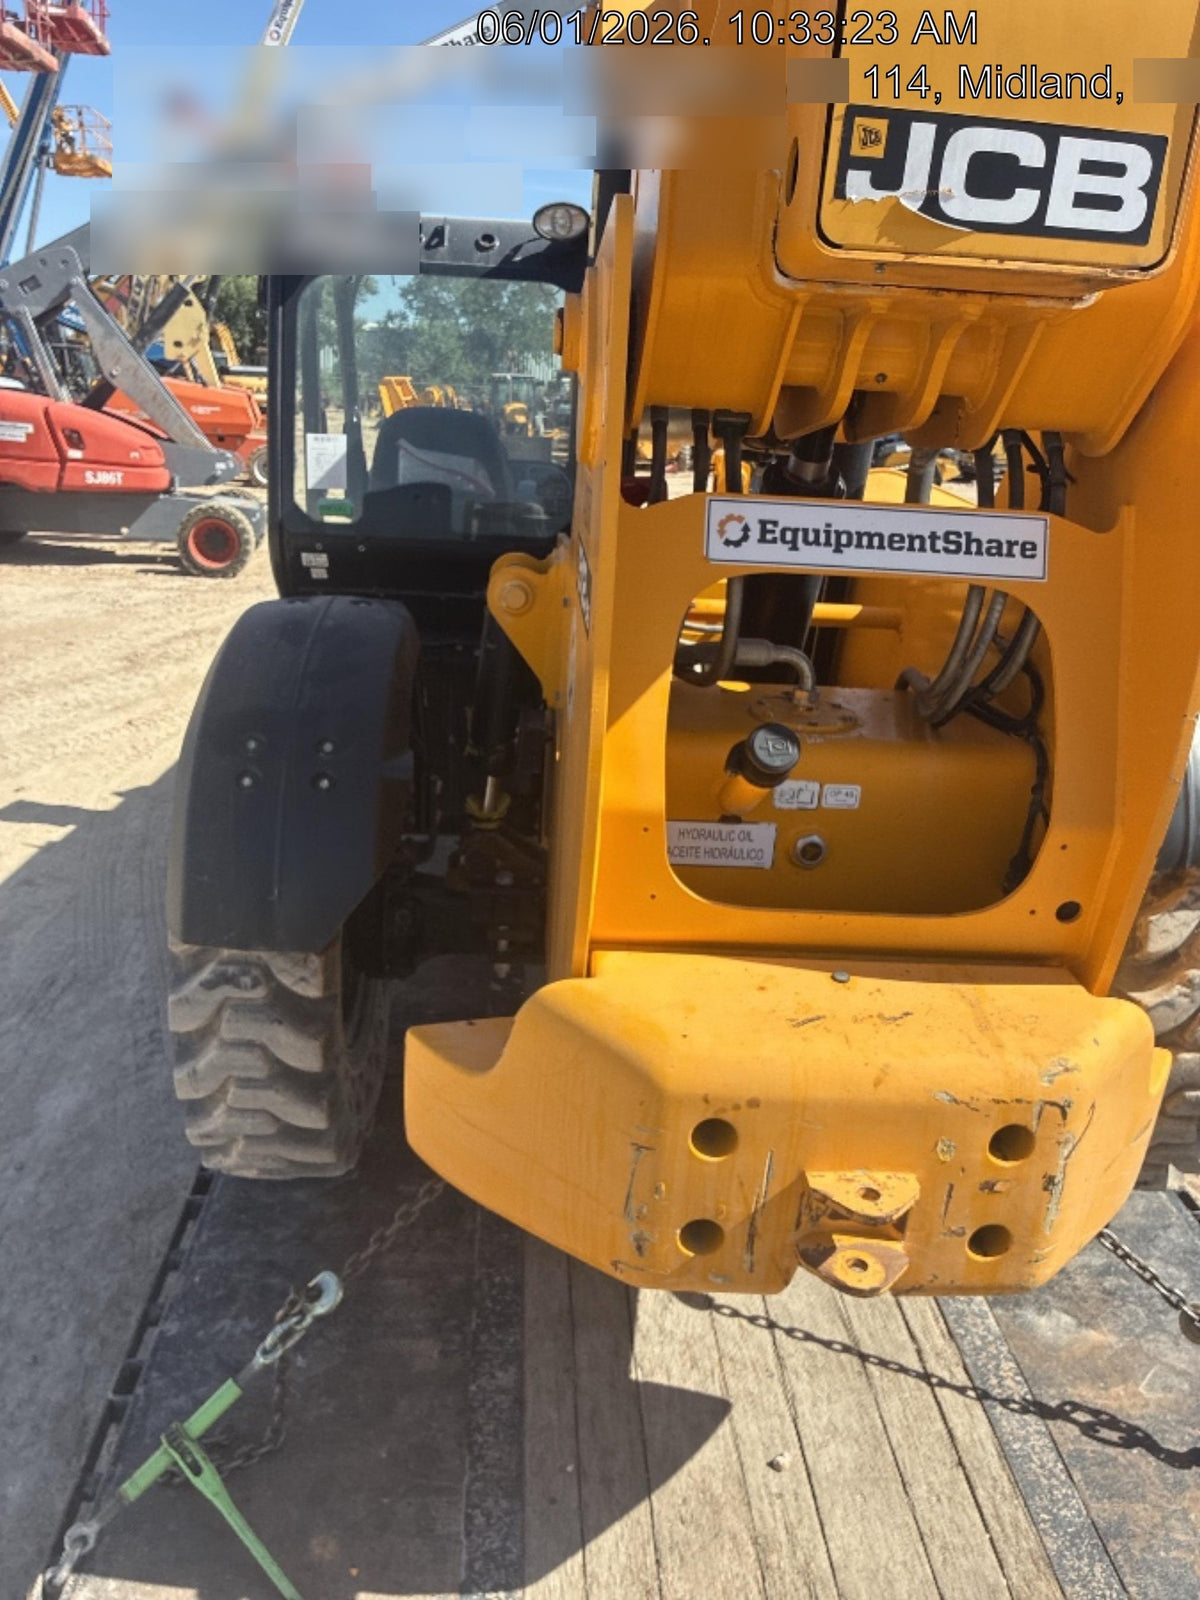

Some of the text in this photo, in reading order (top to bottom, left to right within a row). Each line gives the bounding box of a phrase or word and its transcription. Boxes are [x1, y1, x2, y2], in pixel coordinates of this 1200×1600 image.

[845, 121, 1153, 233] JCB
[757, 518, 1038, 560] EquipmentShare
[679, 827, 754, 842] HYDRAULIC OIL
